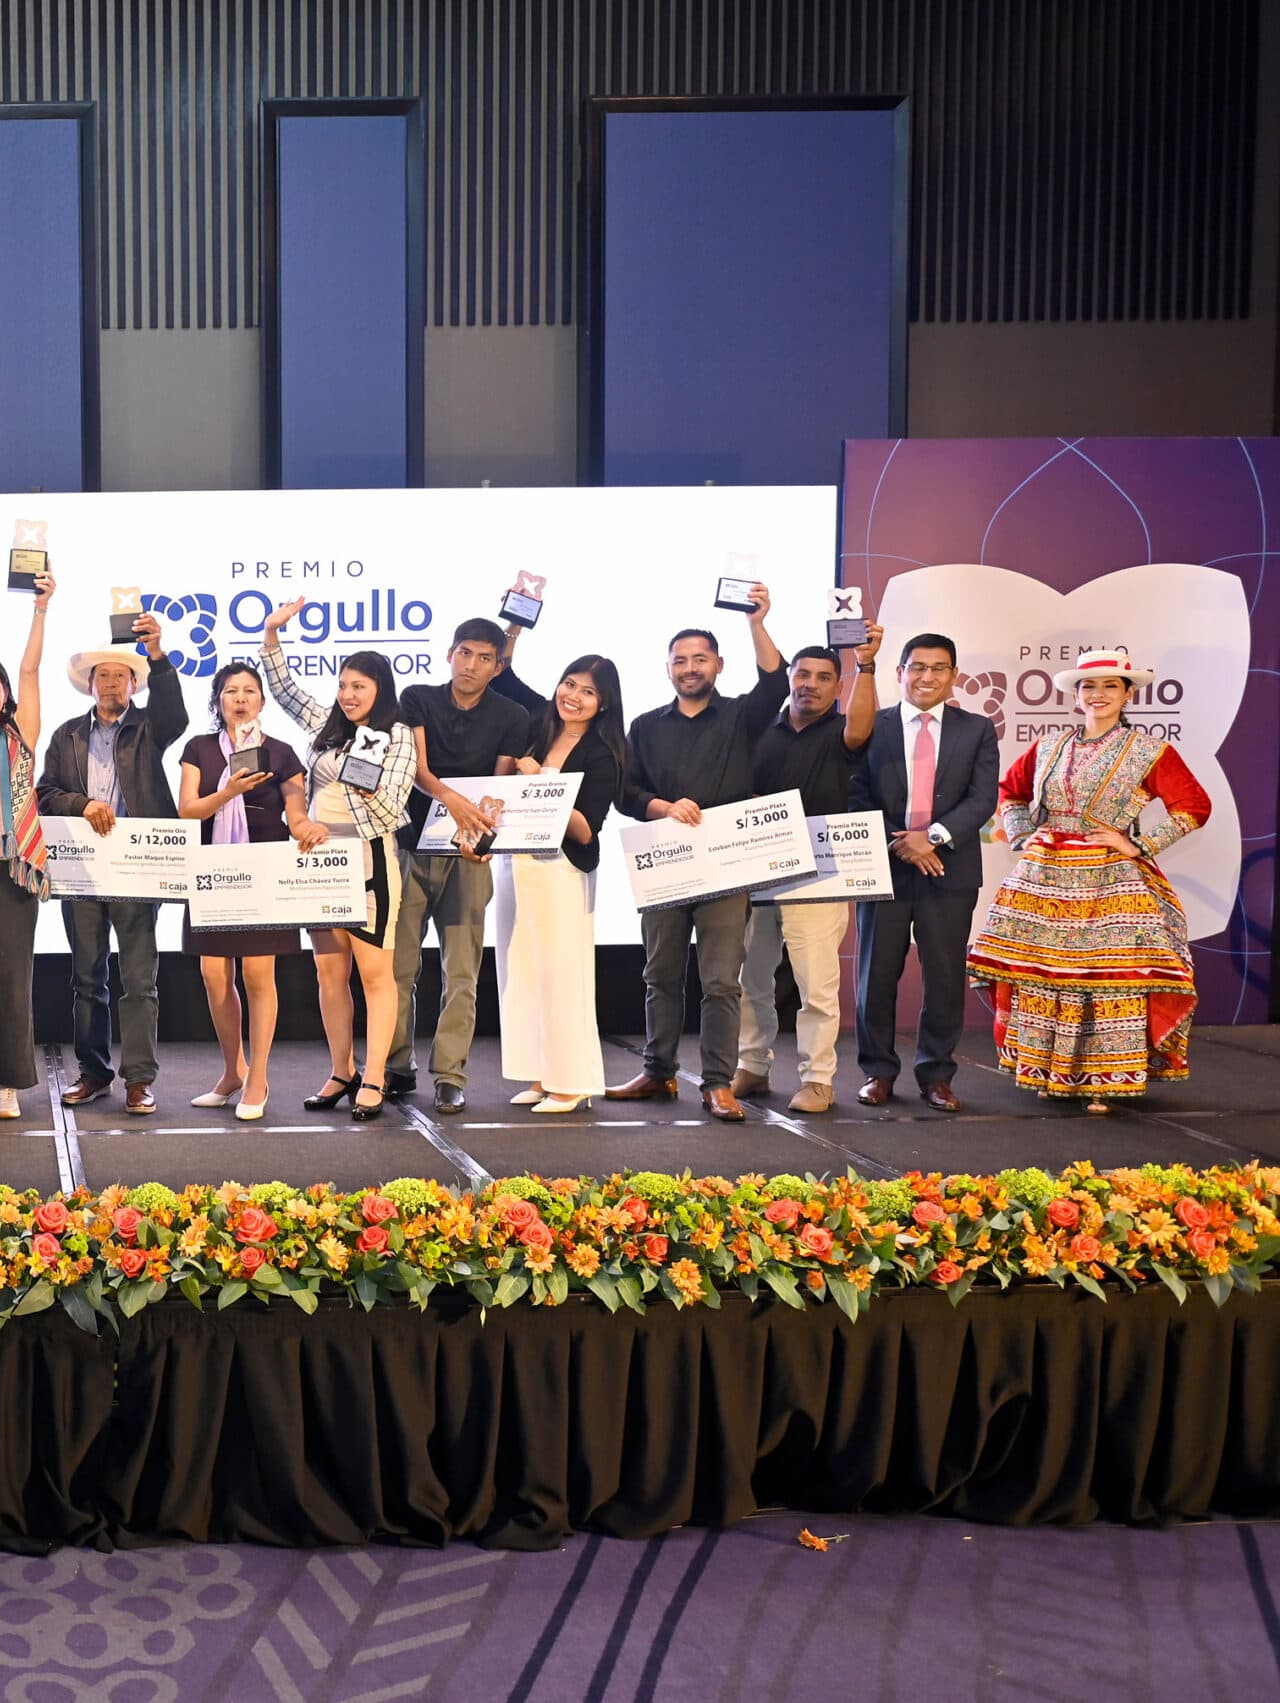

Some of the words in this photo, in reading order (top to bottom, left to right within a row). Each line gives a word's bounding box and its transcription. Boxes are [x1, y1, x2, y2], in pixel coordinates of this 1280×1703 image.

[231, 560, 365, 579] PREMIO
[520, 789, 533, 799] S/
[533, 788, 565, 799] 3,000
[745, 805, 769, 815] Premio
[769, 802, 787, 810] Plata
[735, 817, 749, 830] S/
[751, 809, 789, 826] 3,000
[130, 834, 142, 845] S/
[145, 834, 187, 846] 12,000
[533, 832, 551, 842] caja
[816, 831, 829, 843] S/
[832, 829, 869, 842] 6,000
[58, 844, 96, 855] Orgullo
[652, 844, 693, 859] Orgullo
[296, 857, 309, 868] S/
[311, 856, 348, 868] 3,000
[778, 857, 800, 869] caja
[213, 873, 252, 883] Orgullo
[855, 876, 876, 887] caja
[168, 882, 188, 892] caja
[331, 904, 352, 914] caja
